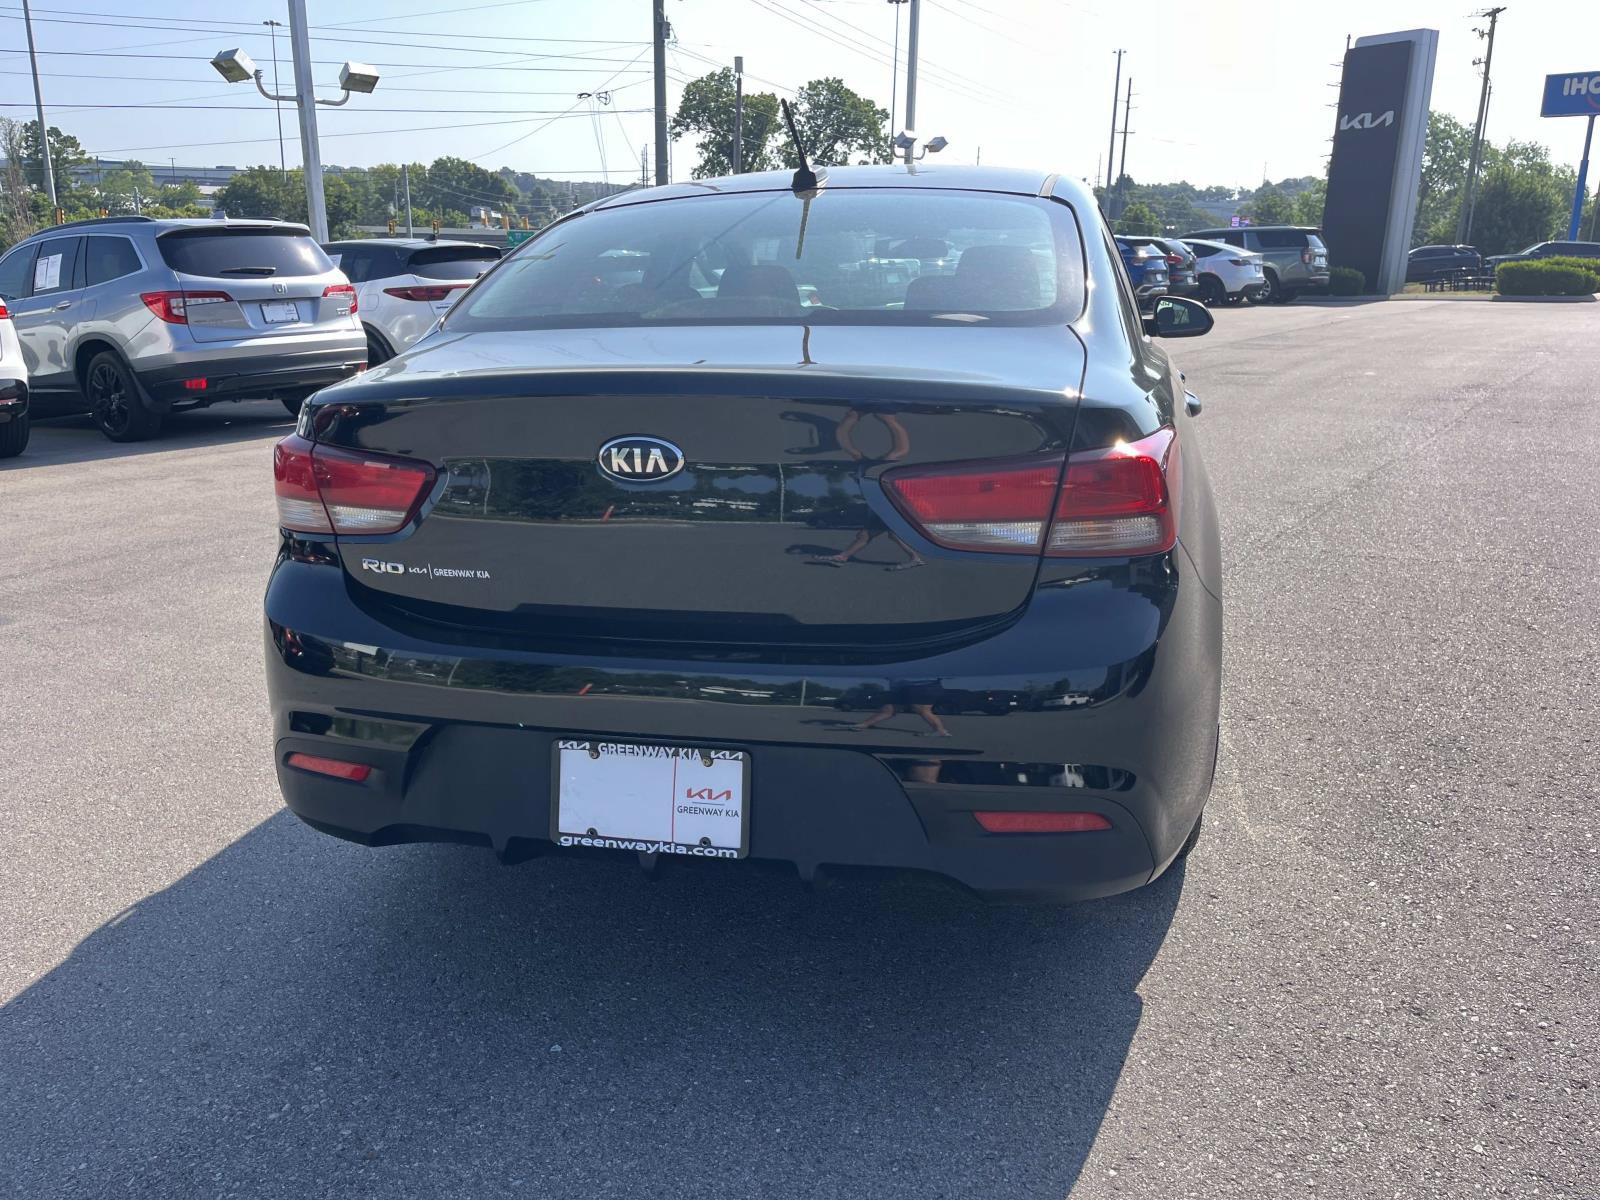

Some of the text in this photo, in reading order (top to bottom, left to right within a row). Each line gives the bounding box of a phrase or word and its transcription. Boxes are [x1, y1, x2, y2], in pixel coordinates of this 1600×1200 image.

[1340, 110, 1394, 130] KIA
[610, 447, 669, 473] KIA
[362, 558, 405, 574] RIO
[433, 568, 475, 578] GREENWAY
[476, 570, 490, 579] KIA
[598, 742, 675, 759] GREENWAY
[678, 748, 702, 761] KIA
[676, 805, 739, 818] GREENWAY KIA
[559, 835, 738, 859] greenwaykia.com
